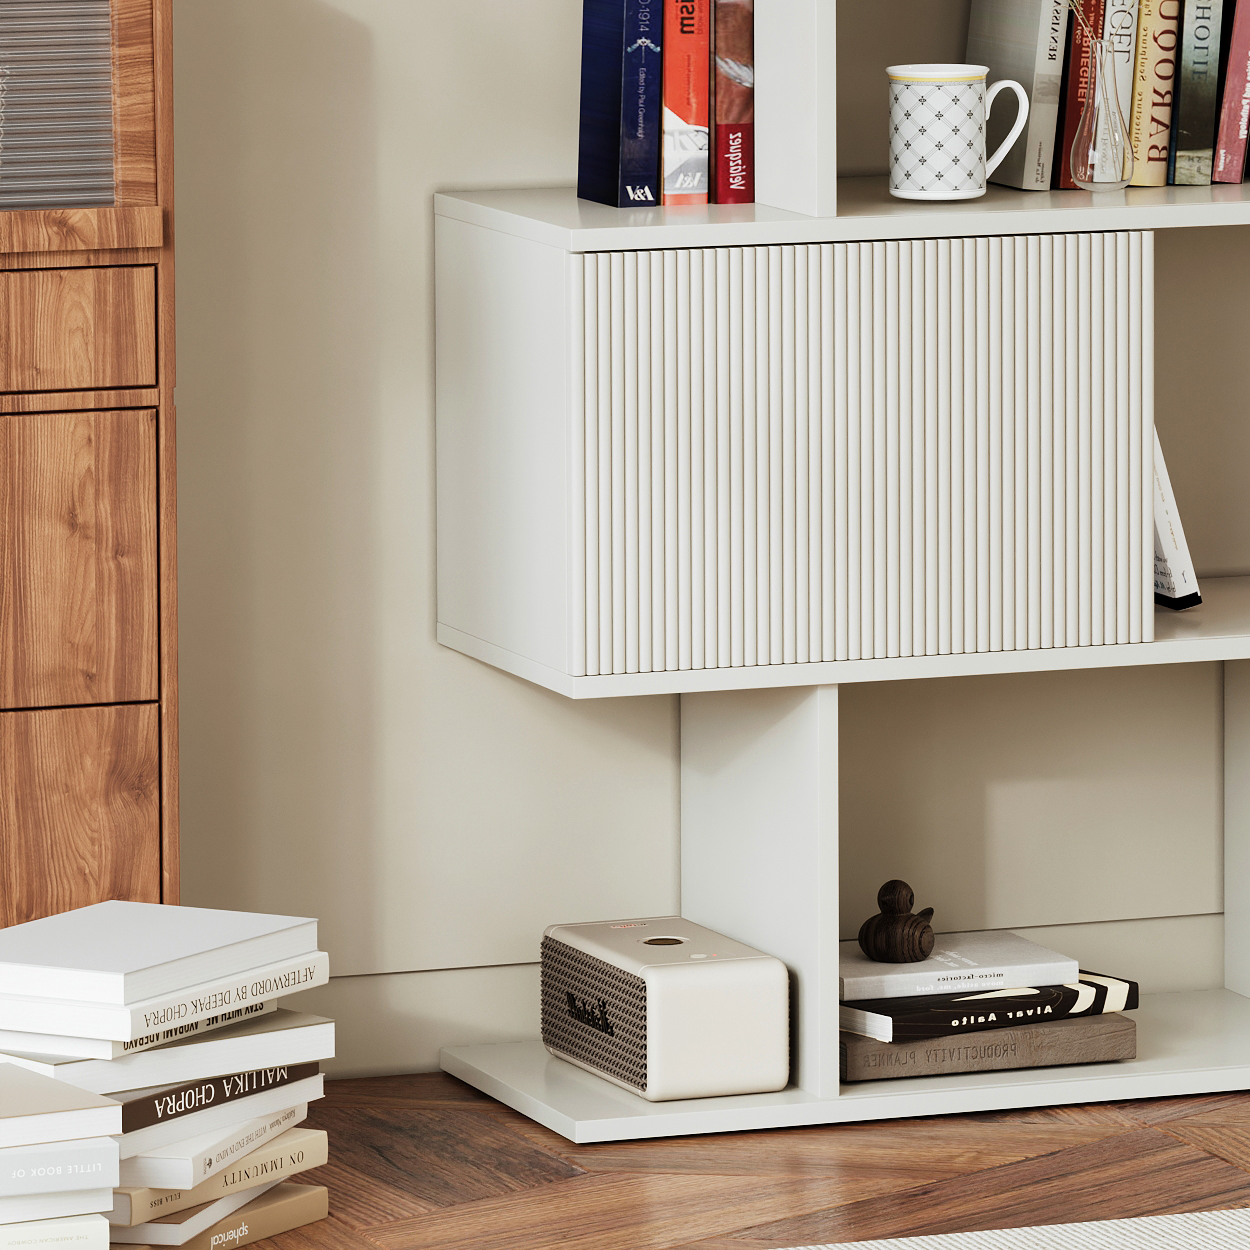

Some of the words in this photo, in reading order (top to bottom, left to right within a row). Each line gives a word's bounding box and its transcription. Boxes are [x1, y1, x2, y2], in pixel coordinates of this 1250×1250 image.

[625, 185, 655, 201] V&A
[251, 965, 316, 997] AFTERWORD
[234, 985, 248, 1003] BY
[191, 990, 232, 1015] DEEPAK
[144, 1003, 188, 1028] CHOPRA
[223, 1066, 288, 1098] MALLIKA
[154, 1083, 215, 1119] CHOPRA
[234, 1137, 246, 1151] END
[245, 1131, 256, 1146] THE
[215, 1150, 230, 1163] MIND
[288, 1150, 305, 1167] ON
[10, 1167, 26, 1180] OF
[30, 1165, 62, 1177] BOOK
[63, 1162, 102, 1174] LITTLE
[221, 1157, 283, 1188] IMMUNITY
[149, 1198, 163, 1209] BISS
[165, 1191, 181, 1203] EULA
[210, 1220, 249, 1250] spherical
